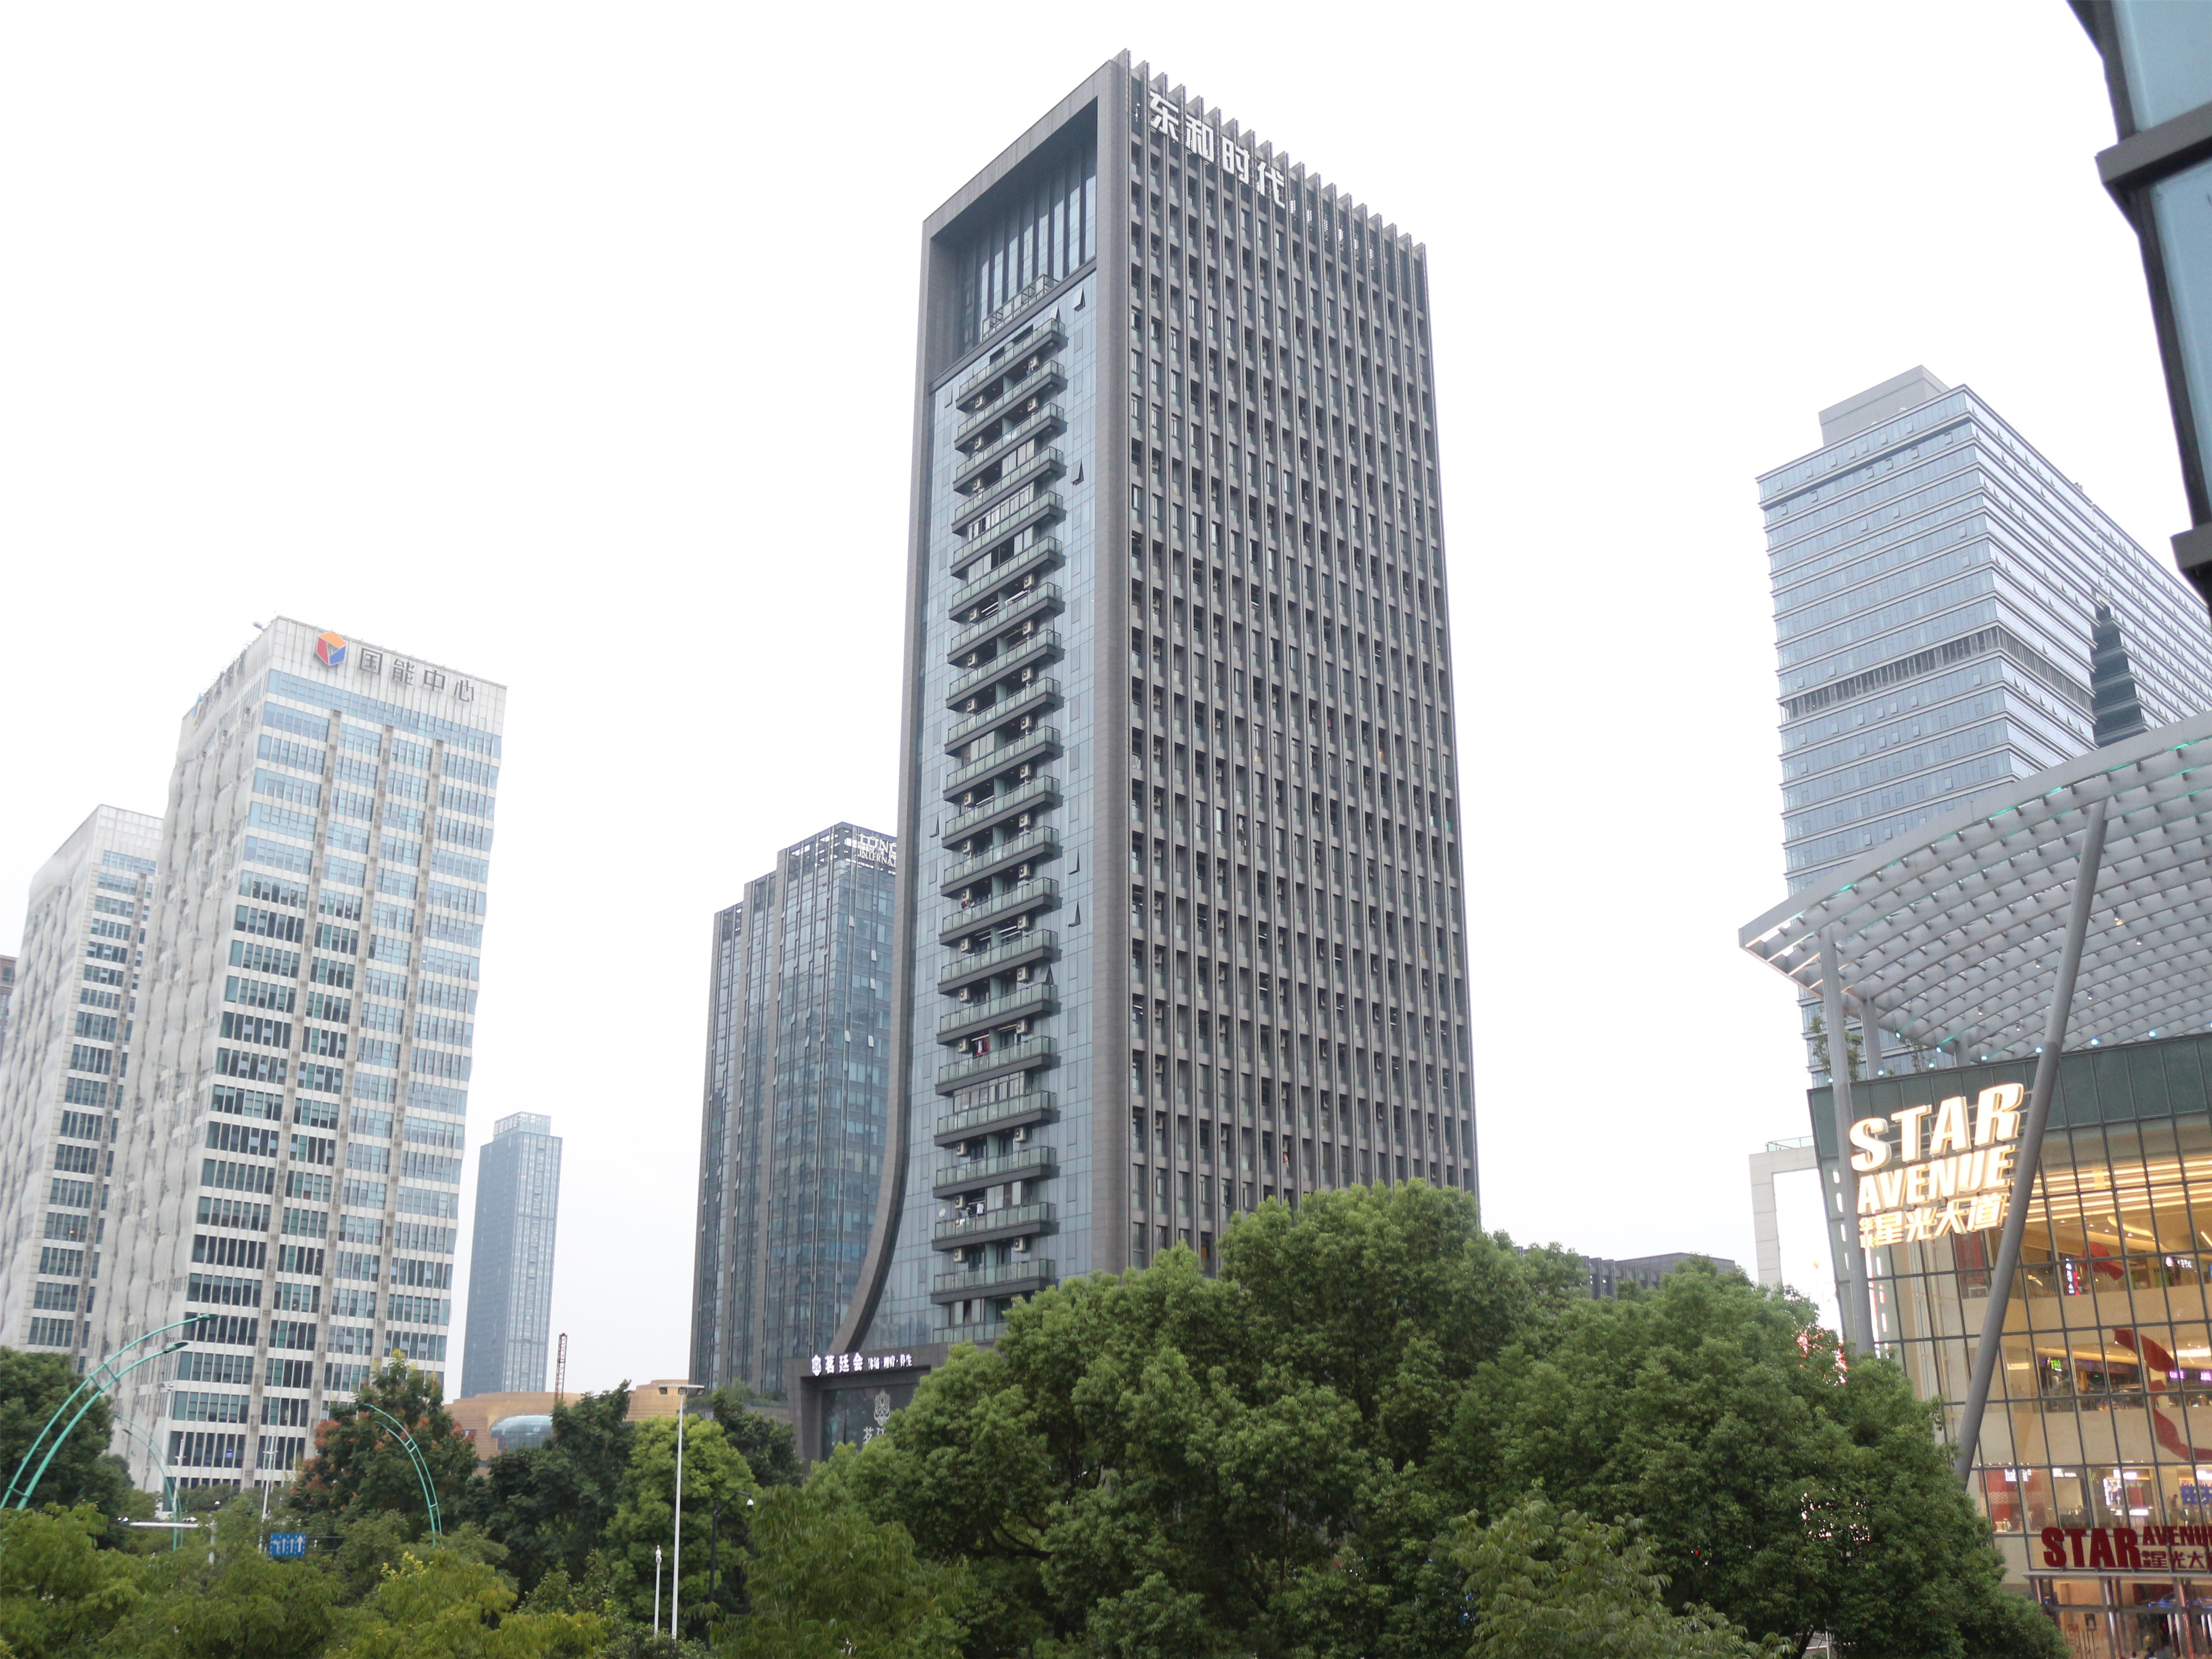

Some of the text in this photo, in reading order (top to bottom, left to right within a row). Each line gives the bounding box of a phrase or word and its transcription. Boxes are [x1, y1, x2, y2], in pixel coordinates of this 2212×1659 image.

[1150, 91, 1285, 209] 东和时代
[359, 648, 474, 702] 国能中心
[1849, 1083, 2025, 1172] STAR
[1857, 1144, 2016, 1215] AVENUE
[2041, 1527, 2142, 1568] STAR
